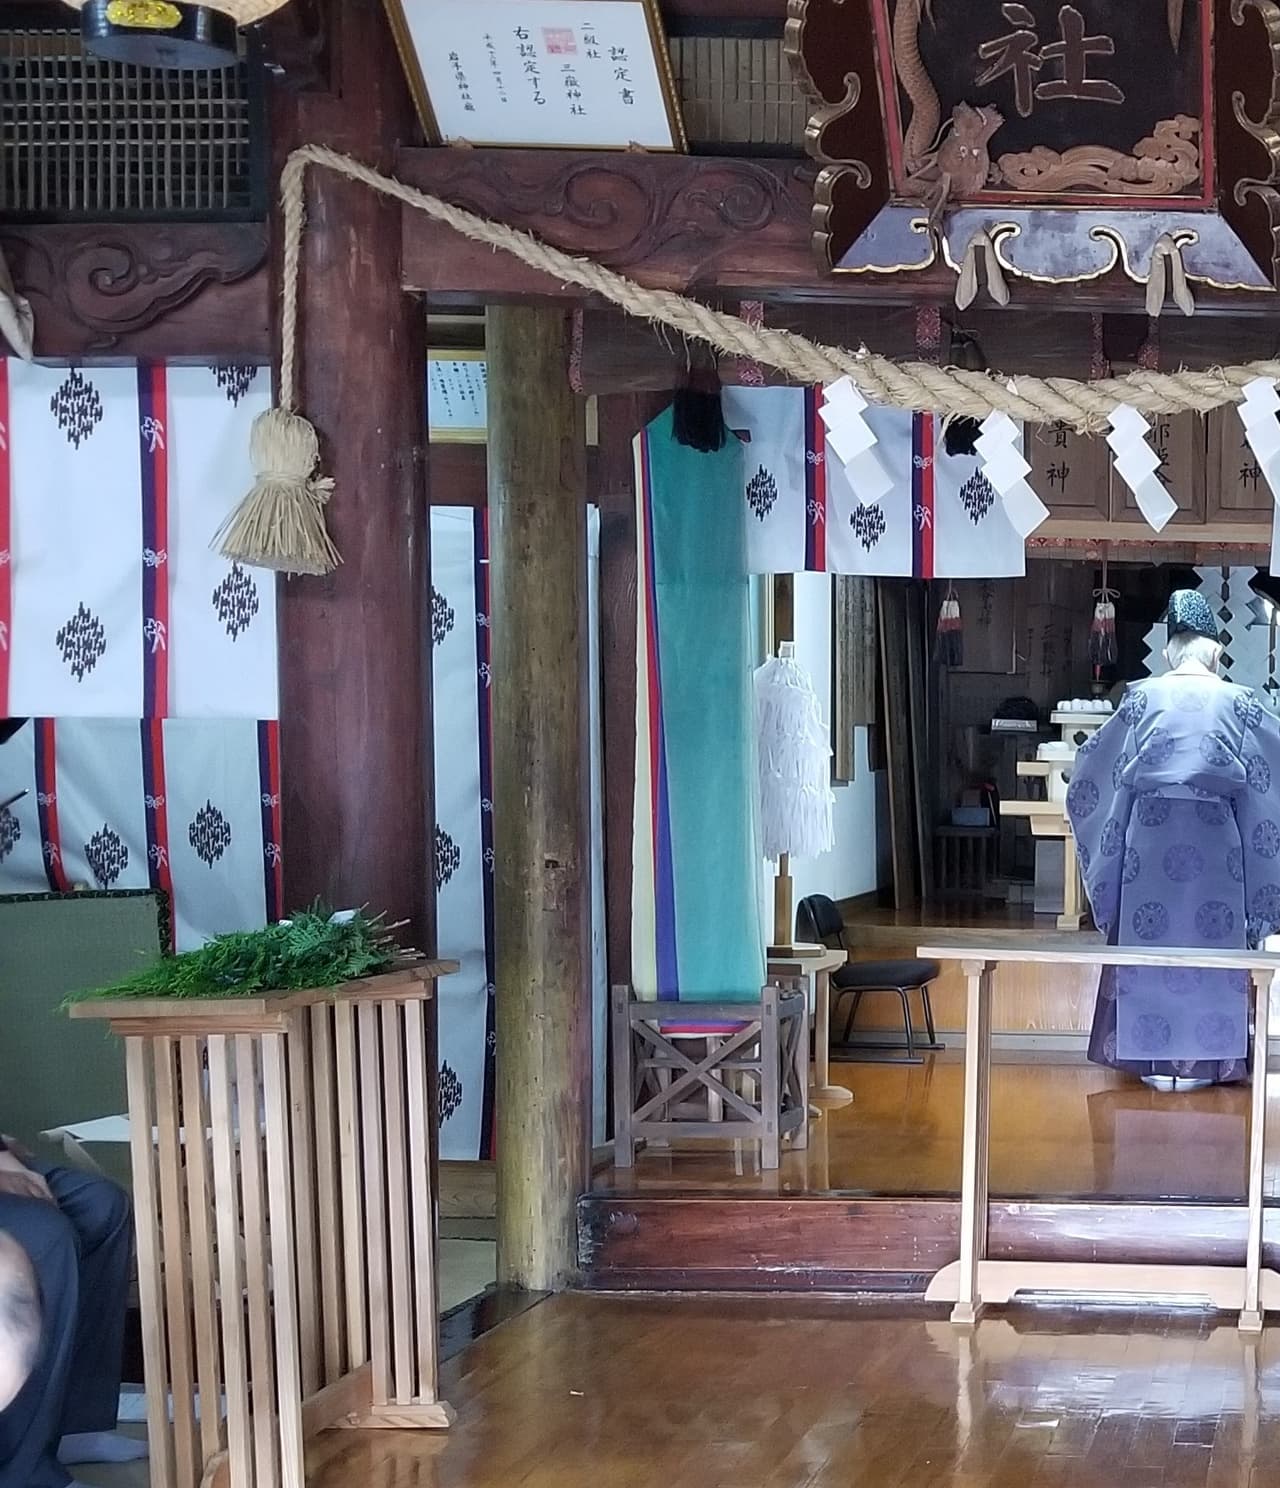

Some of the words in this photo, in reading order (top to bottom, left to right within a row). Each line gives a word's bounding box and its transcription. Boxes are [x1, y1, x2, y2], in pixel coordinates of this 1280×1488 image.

[513, 26, 546, 105] 右認定する
[608, 46, 635, 104] 認定書
[975, 3, 1126, 118] 社
